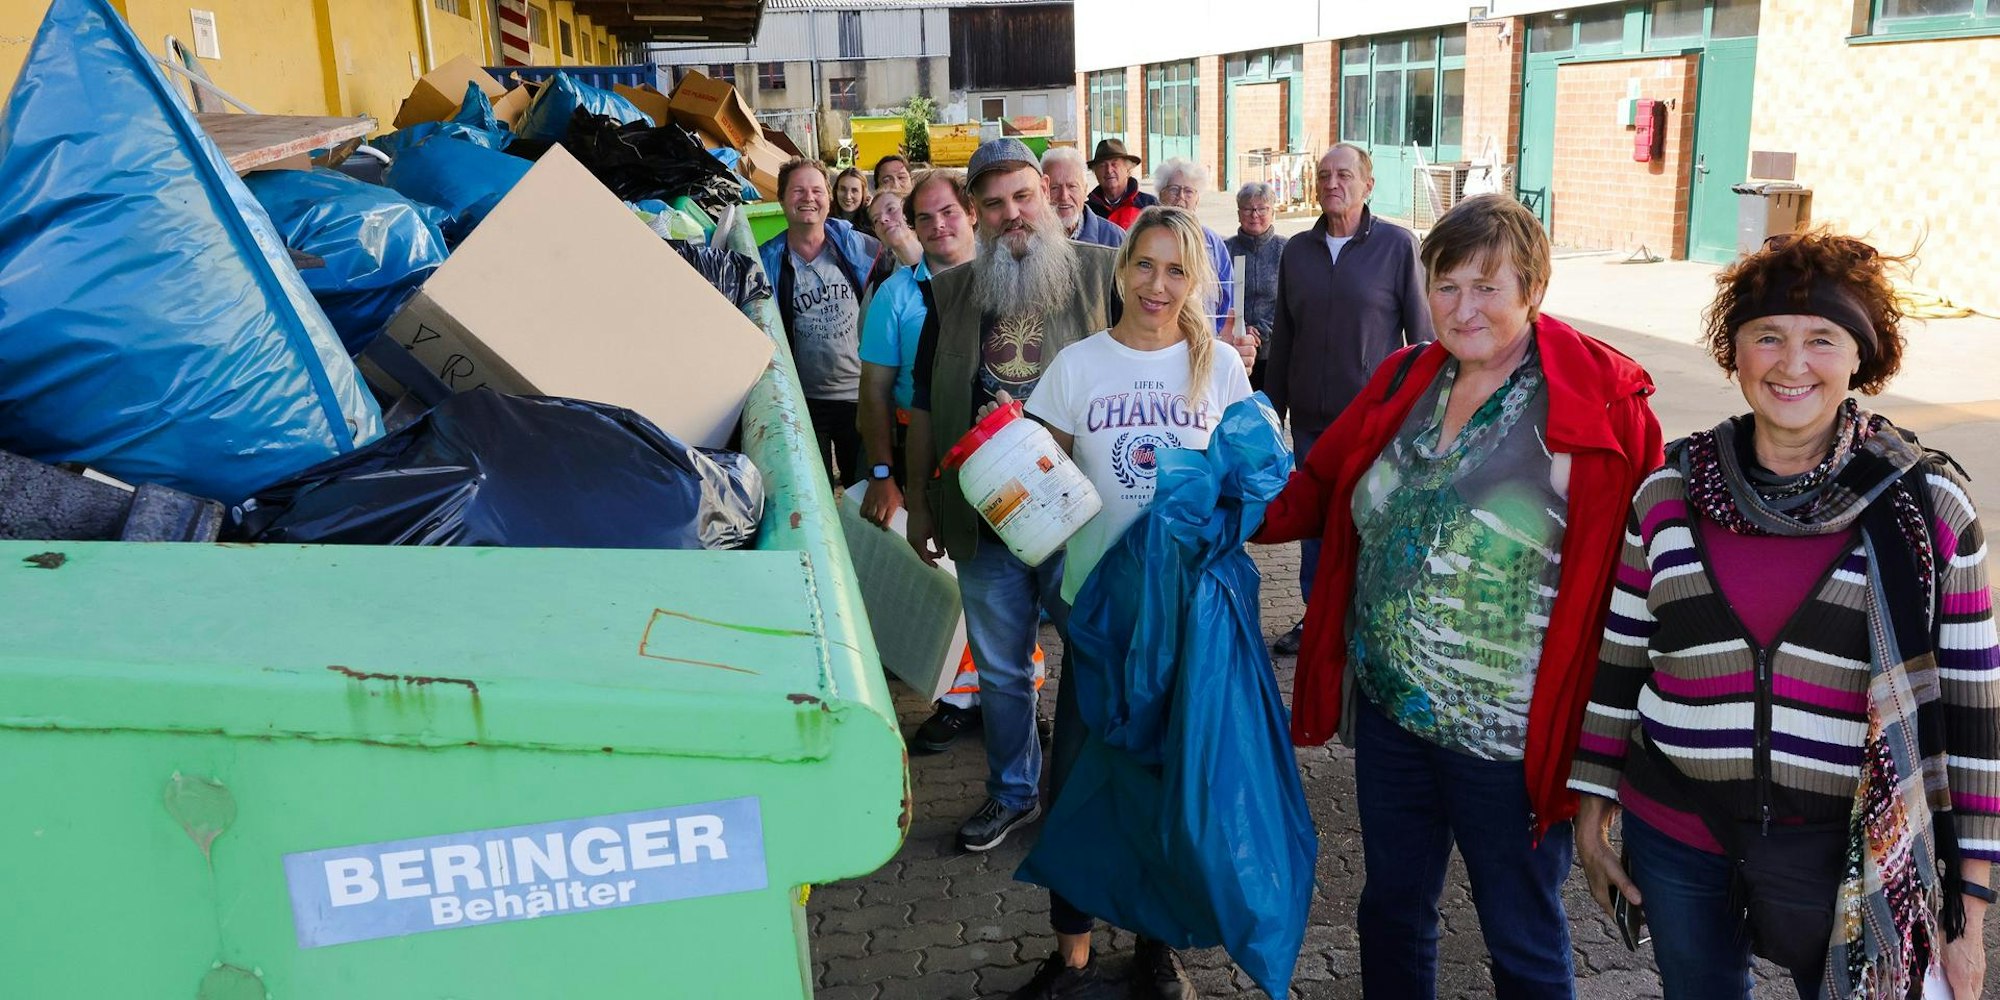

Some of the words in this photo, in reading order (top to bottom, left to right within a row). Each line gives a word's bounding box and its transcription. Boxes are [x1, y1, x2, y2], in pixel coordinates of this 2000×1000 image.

[1134, 381, 1154, 389] LIFE
[1156, 381, 1164, 389] IS
[1087, 392, 1209, 433] CHANGE
[324, 813, 728, 908] BERINGER
[430, 879, 636, 926] Behälter
